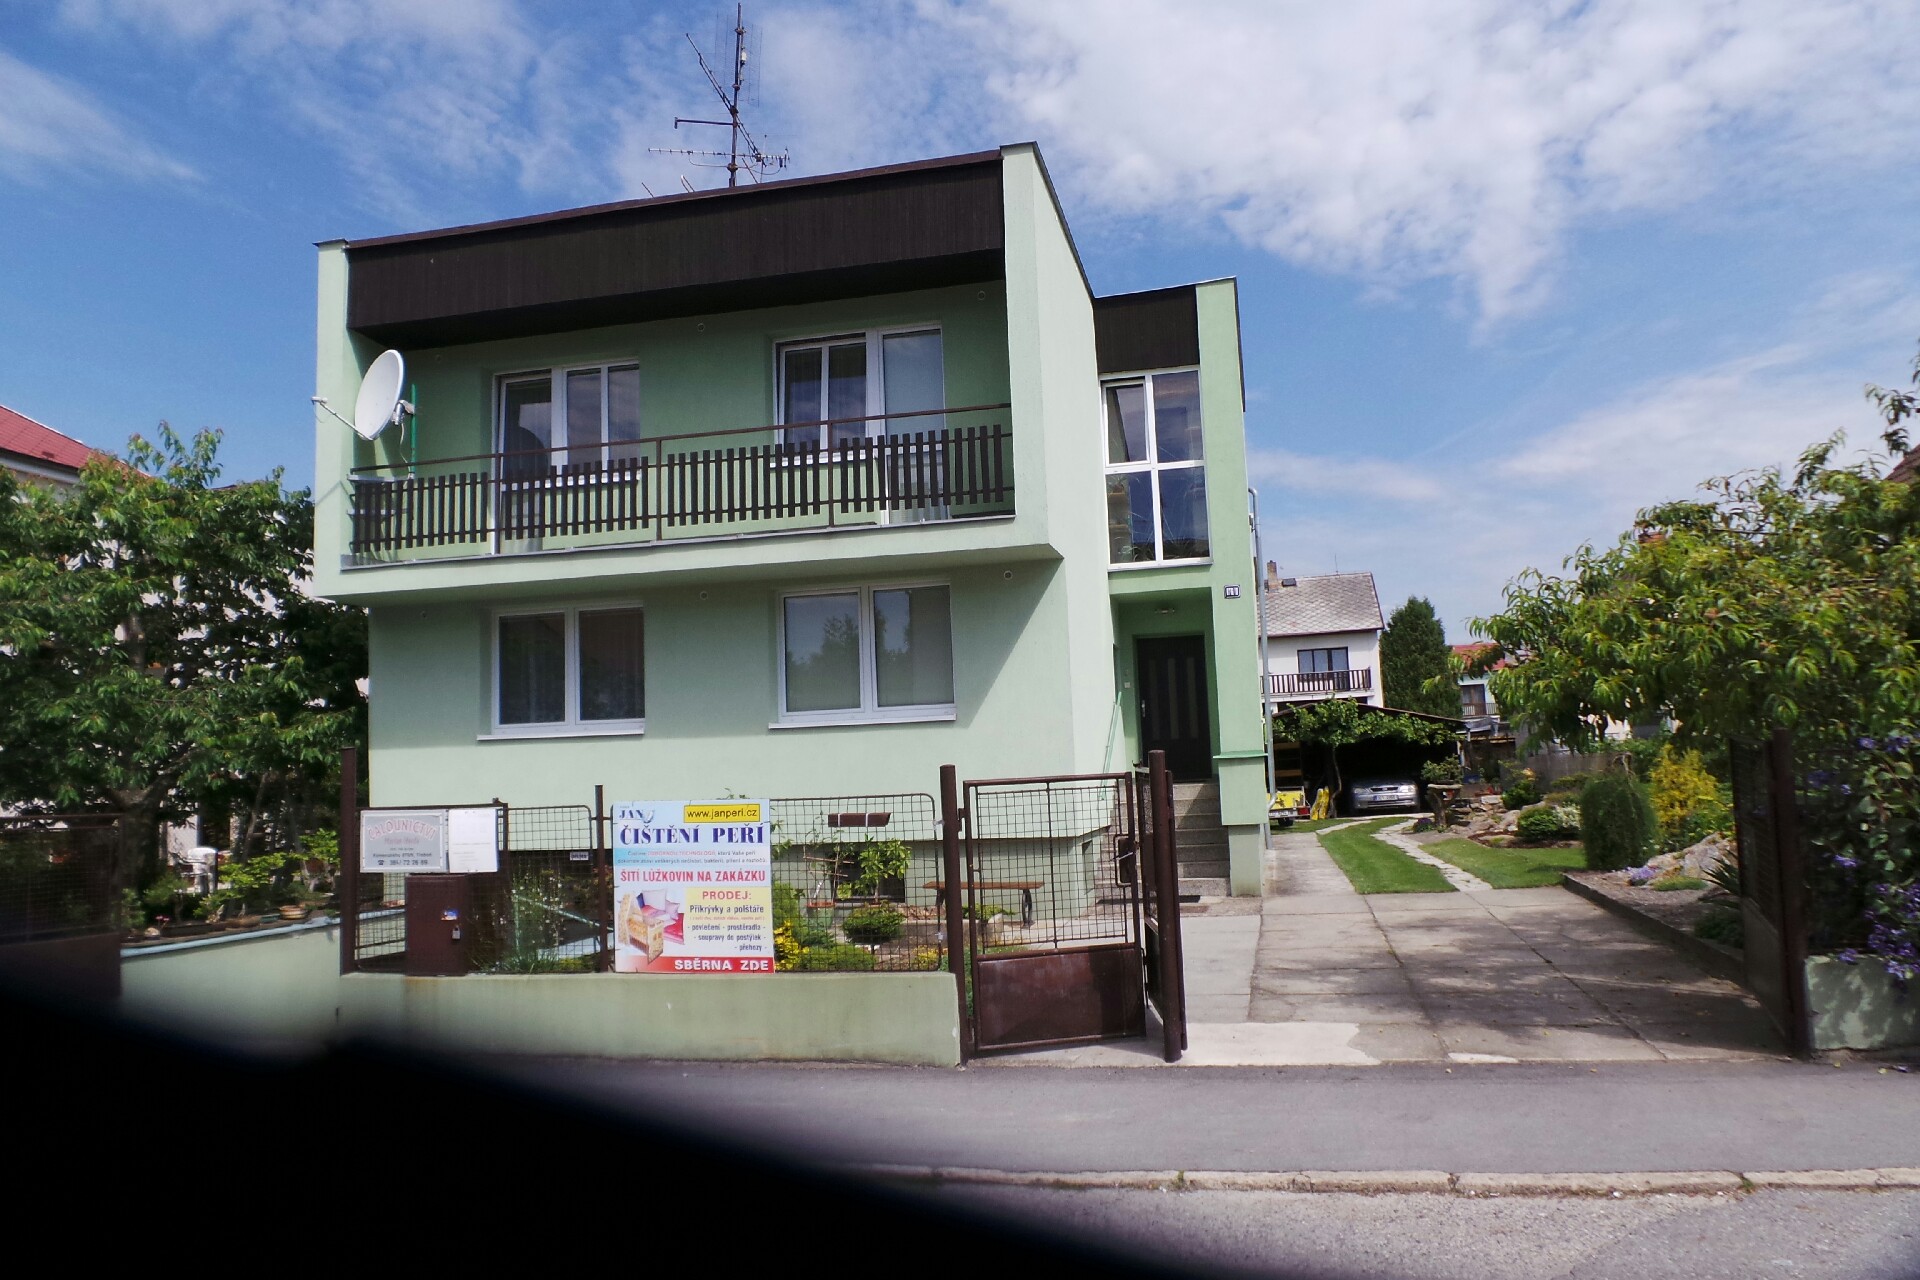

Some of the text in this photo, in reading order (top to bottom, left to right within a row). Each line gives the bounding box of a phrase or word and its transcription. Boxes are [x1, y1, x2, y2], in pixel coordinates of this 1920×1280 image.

[619, 822, 765, 846] ČIŠTĚNÍ PEŘÍ
[620, 868, 766, 882] ŠITÍ LŮŽKOVIN NA ZAKÁZKU
[702, 890, 752, 900] PRODEJ:
[674, 957, 769, 971] SBĚRNA ZDE
